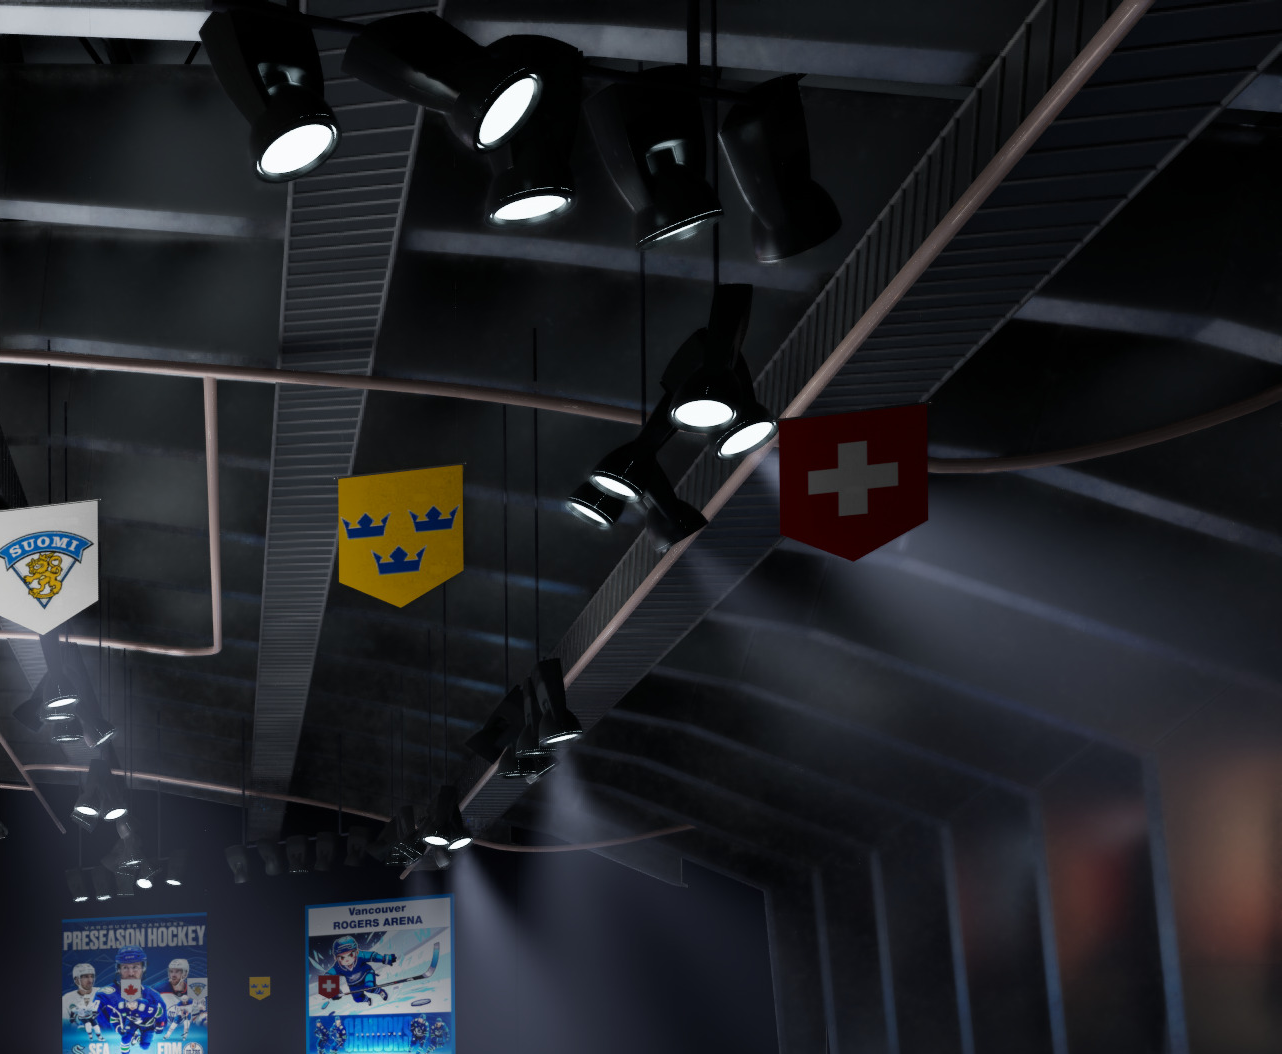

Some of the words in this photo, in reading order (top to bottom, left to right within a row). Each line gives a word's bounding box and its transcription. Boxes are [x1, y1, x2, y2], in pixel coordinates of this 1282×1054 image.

[9, 536, 80, 558] SUOMI
[348, 904, 407, 916] Vancouver
[333, 918, 380, 930] ROGERS
[383, 915, 424, 928] ARENA
[62, 928, 146, 951] PRESEASON
[147, 925, 206, 948] HOCKEY
